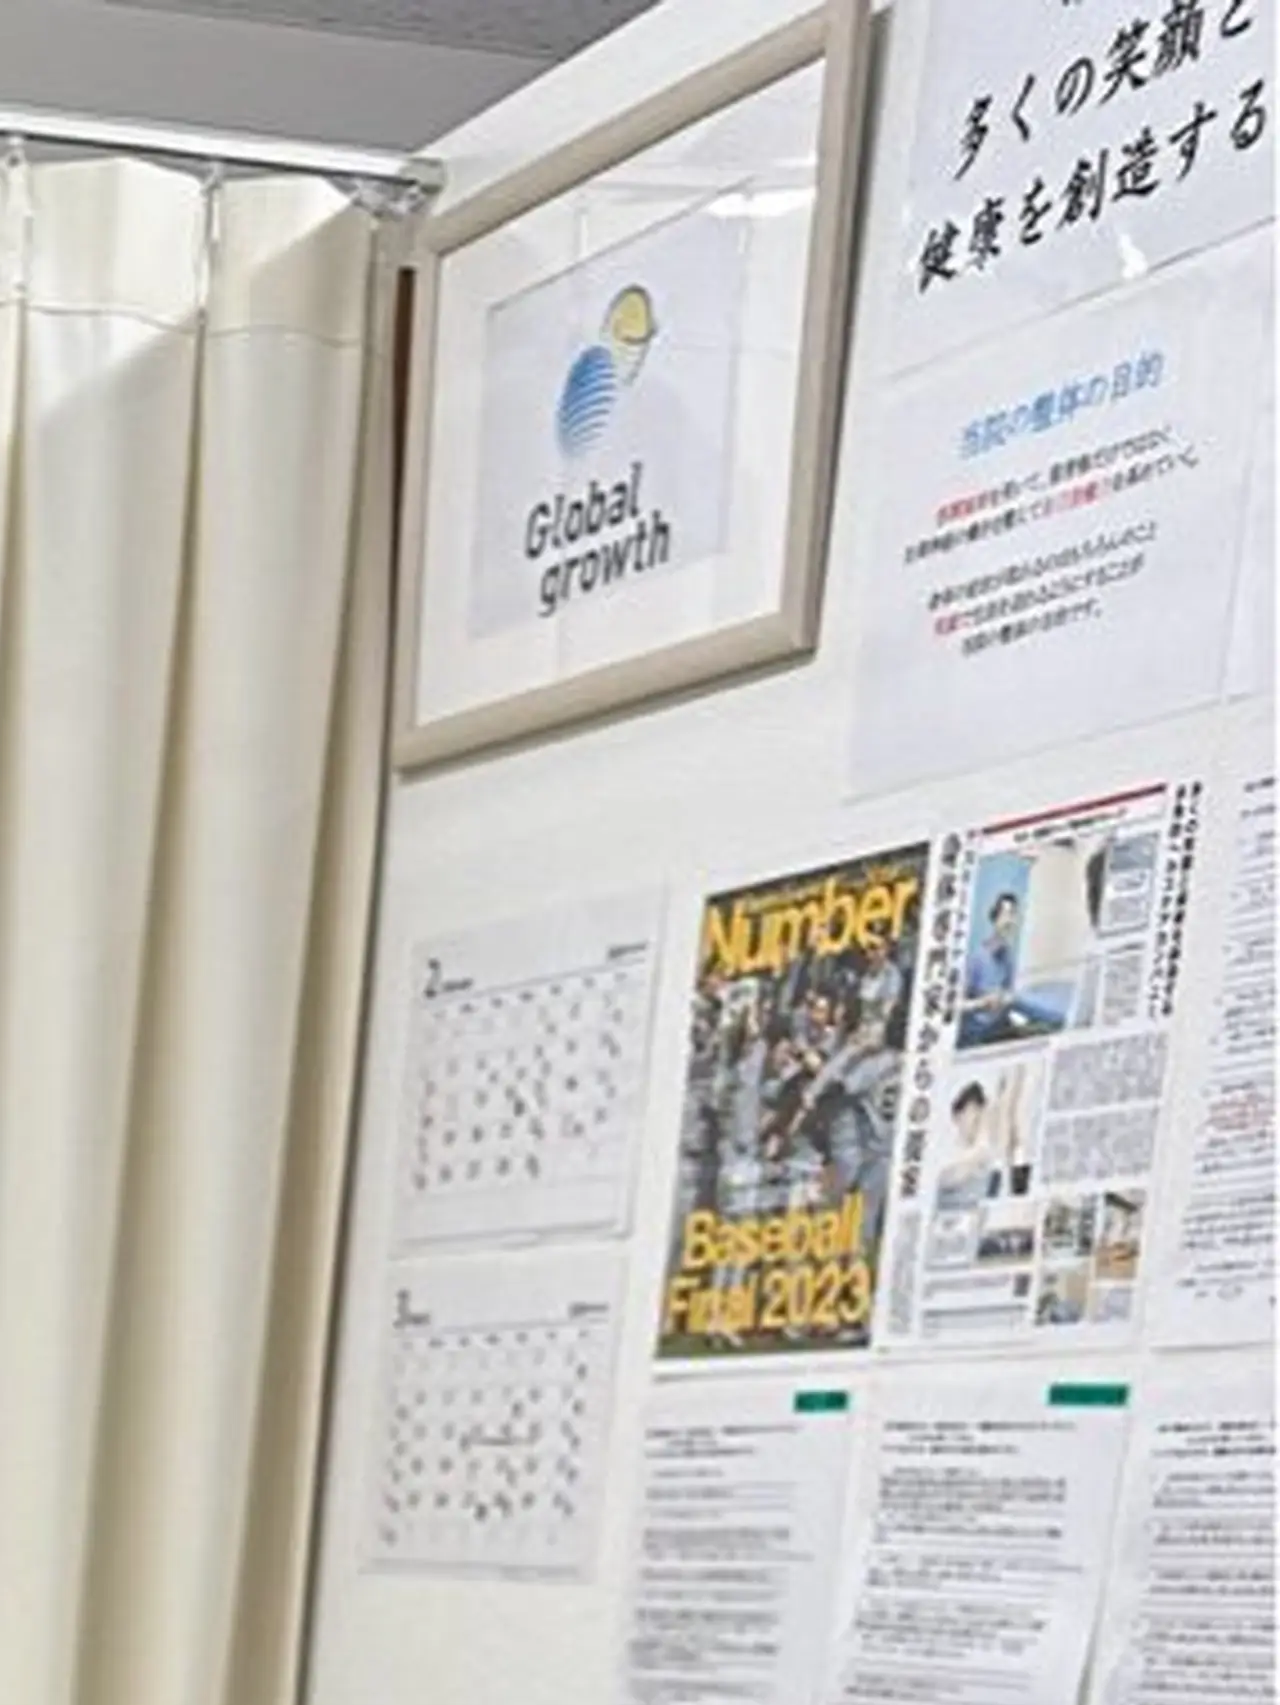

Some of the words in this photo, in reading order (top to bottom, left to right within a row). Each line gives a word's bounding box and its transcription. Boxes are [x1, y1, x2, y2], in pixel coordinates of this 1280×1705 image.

[919, 79, 1267, 294] 健康を創造する
[524, 461, 643, 560] Global
[539, 509, 671, 618] growth
[703, 873, 918, 977] Number
[682, 1190, 864, 1269] Baseball
[668, 1274, 759, 1336] Final
[761, 1260, 871, 1328] 2023
